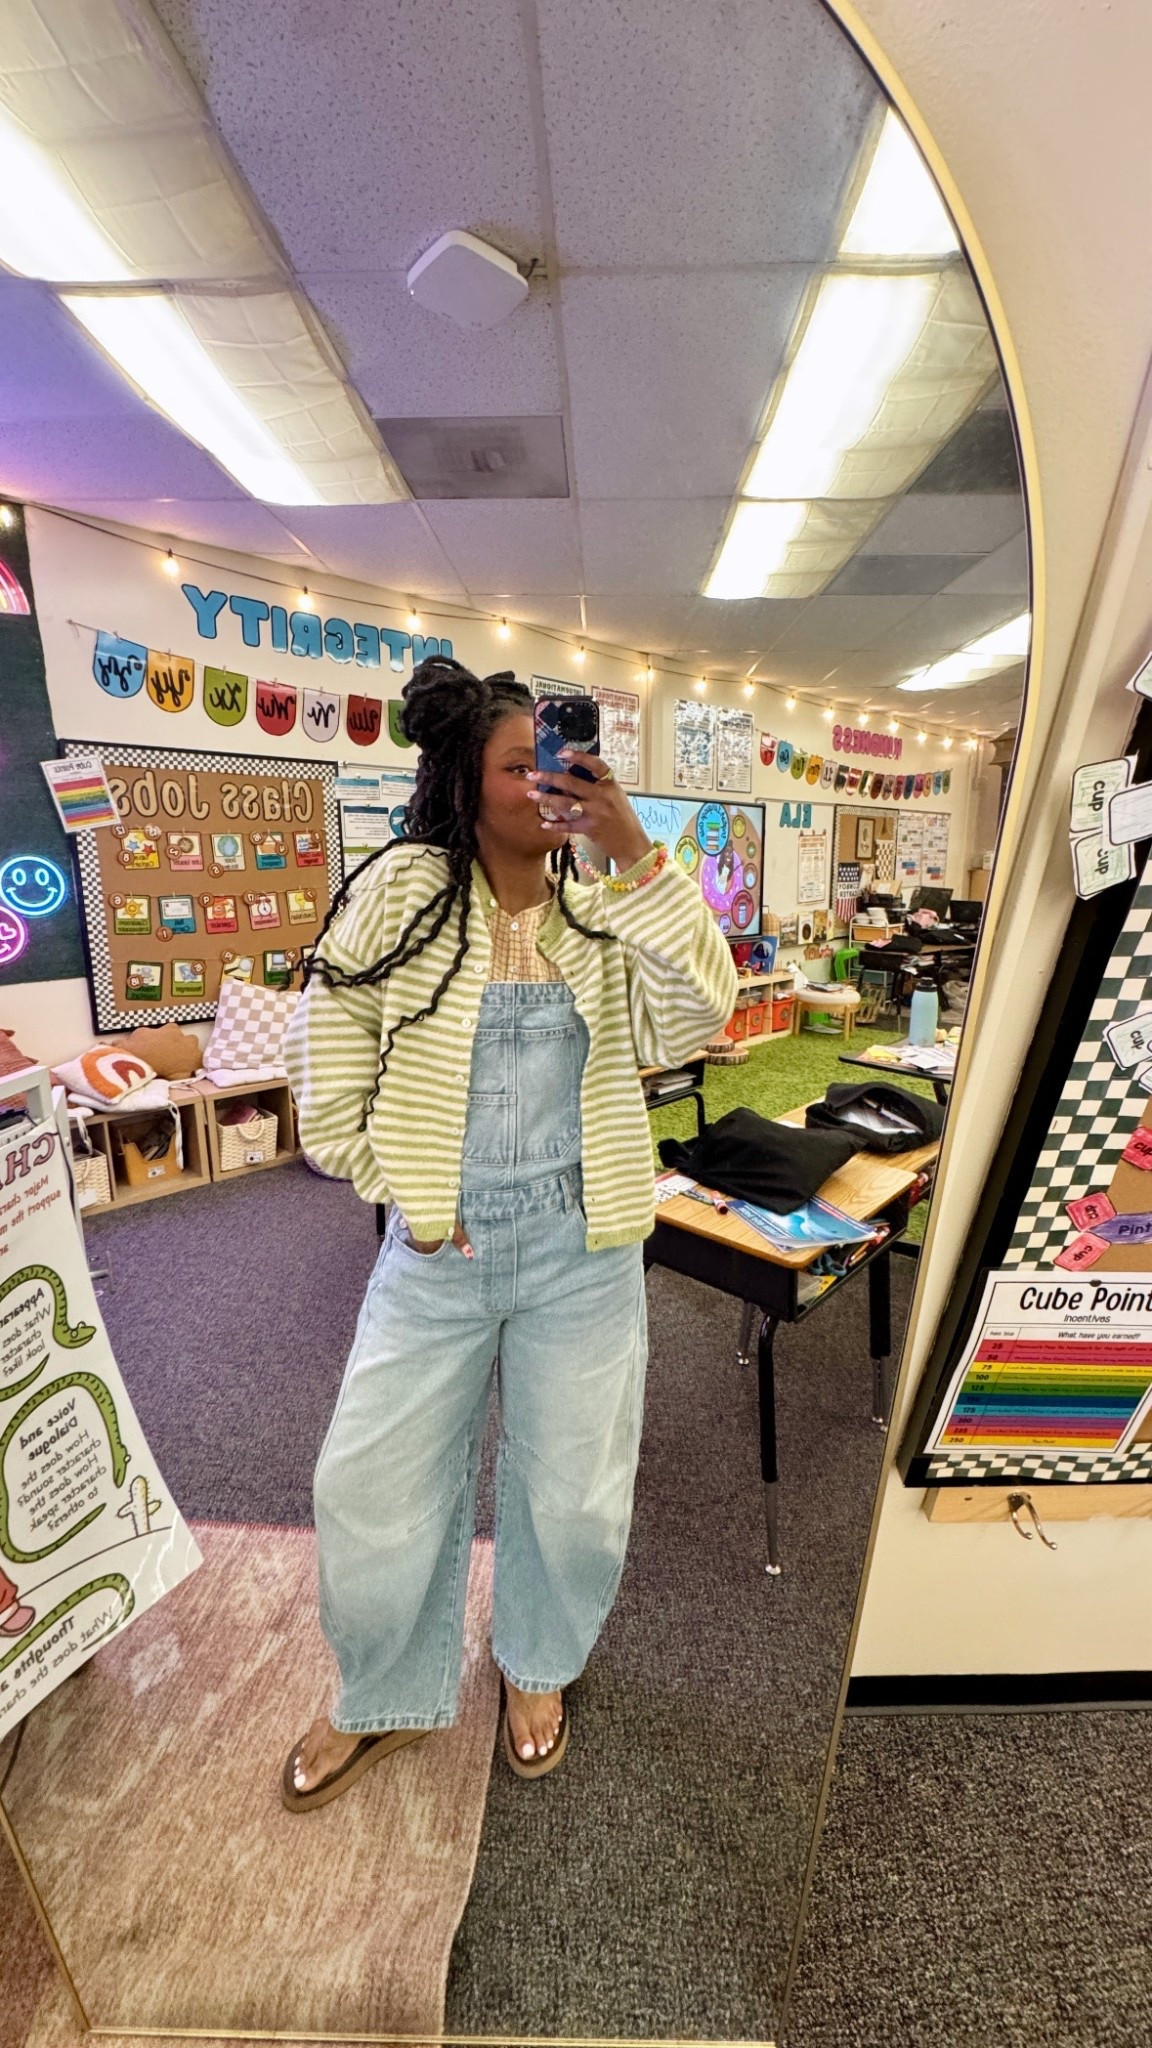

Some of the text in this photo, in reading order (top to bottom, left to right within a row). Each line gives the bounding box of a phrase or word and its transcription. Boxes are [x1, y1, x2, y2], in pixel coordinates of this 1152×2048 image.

[1088, 781, 1105, 811] cup
[1073, 1245, 1093, 1261] cup
[1019, 1287, 1084, 1310] Cube
[1063, 1313, 1111, 1324] Incentives
[1058, 1331, 1141, 1341] What have you earned?
[962, 1406, 977, 1414] 175
